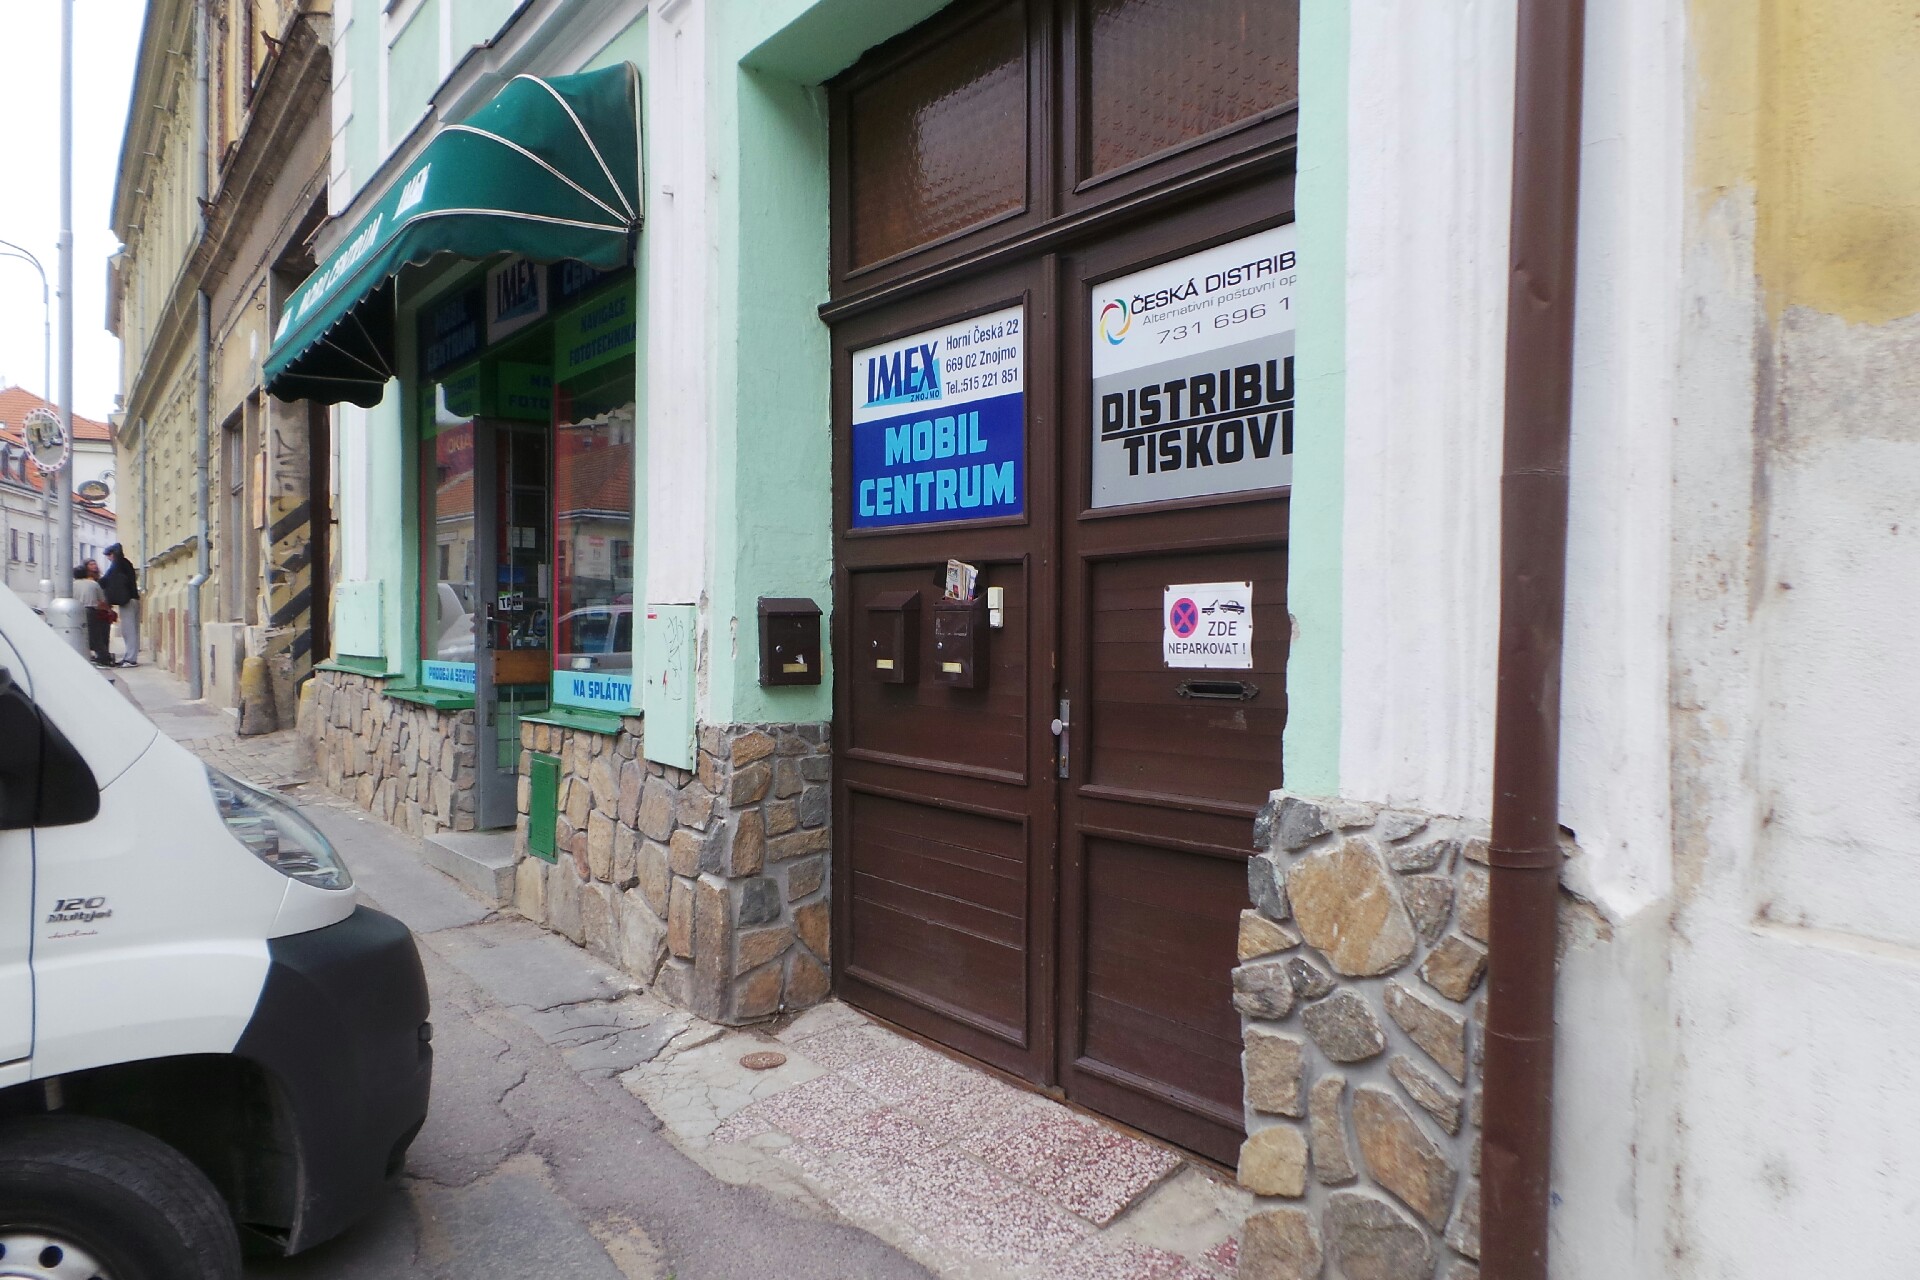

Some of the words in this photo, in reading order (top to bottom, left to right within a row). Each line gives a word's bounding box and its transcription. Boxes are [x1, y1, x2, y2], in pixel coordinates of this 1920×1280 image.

[496, 258, 539, 316] IMEX
[1131, 278, 1198, 315] ČESKÁ
[1205, 251, 1296, 293] DISTRIB
[581, 296, 626, 332] NAVIGACE
[1142, 296, 1214, 326] Alternativní
[1217, 279, 1276, 307] poštovní
[946, 330, 971, 351] Horní
[973, 322, 1003, 344] Česká
[1006, 319, 1019, 336] 22
[1156, 321, 1201, 345] 731
[1214, 303, 1266, 329] 696
[867, 340, 939, 404] IMEX
[946, 356, 963, 373] 669
[965, 354, 977, 368] 02
[980, 346, 1017, 366] Znojmo
[982, 371, 998, 388] 221
[1001, 367, 1018, 384] 851
[910, 389, 940, 403] ZNOJMO
[1102, 355, 1295, 433] DISTRIBU
[885, 411, 988, 467] MOBIL
[1123, 410, 1294, 476] TISKOVI
[859, 460, 1015, 517] CENTRUM
[1207, 620, 1238, 637] ZDE
[1168, 642, 1239, 655] NEPARKOVAT
[428, 666, 450, 681] PRODEJ
[573, 679, 586, 698] NA
[588, 677, 633, 703] SPLÁTKY
[53, 896, 106, 912] 120
